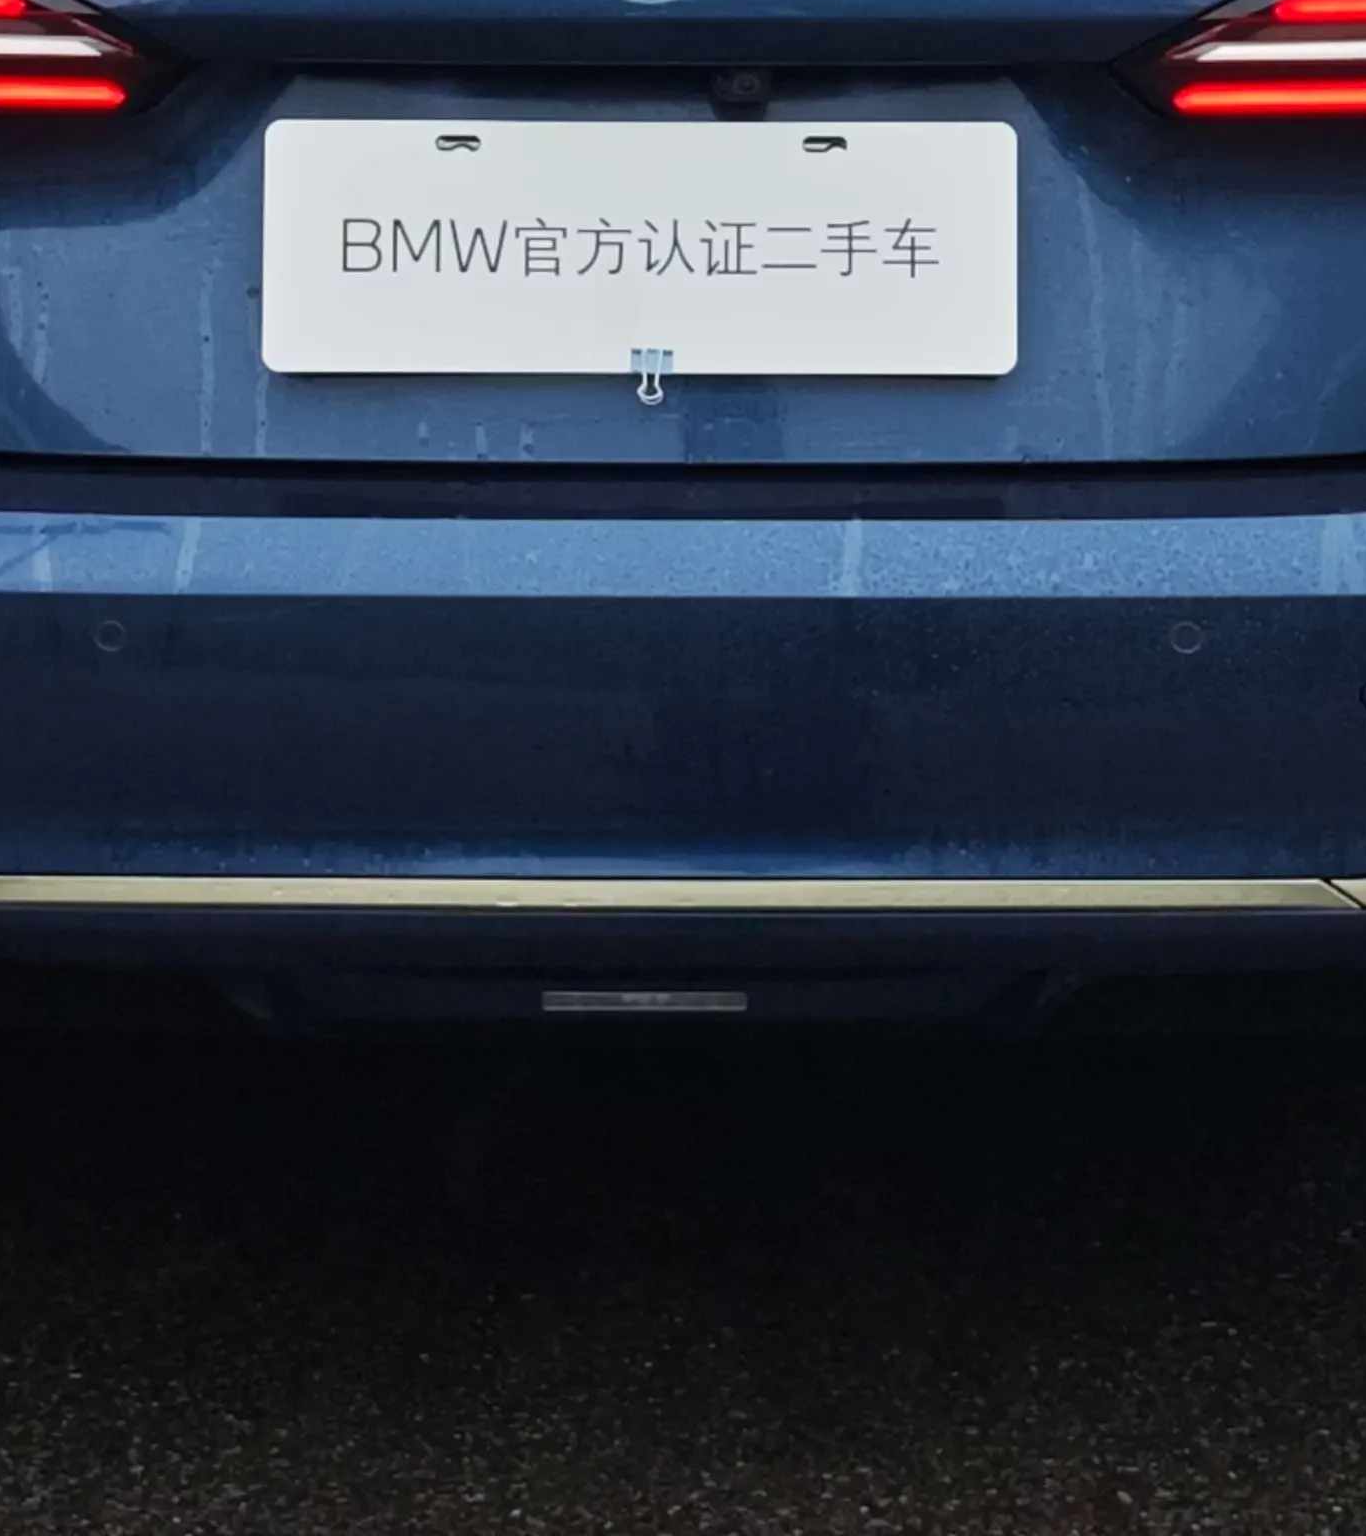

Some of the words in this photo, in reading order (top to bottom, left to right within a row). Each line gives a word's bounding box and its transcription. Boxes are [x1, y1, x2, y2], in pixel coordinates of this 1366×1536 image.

[341, 216, 940, 278] BMW官方认证二手车
